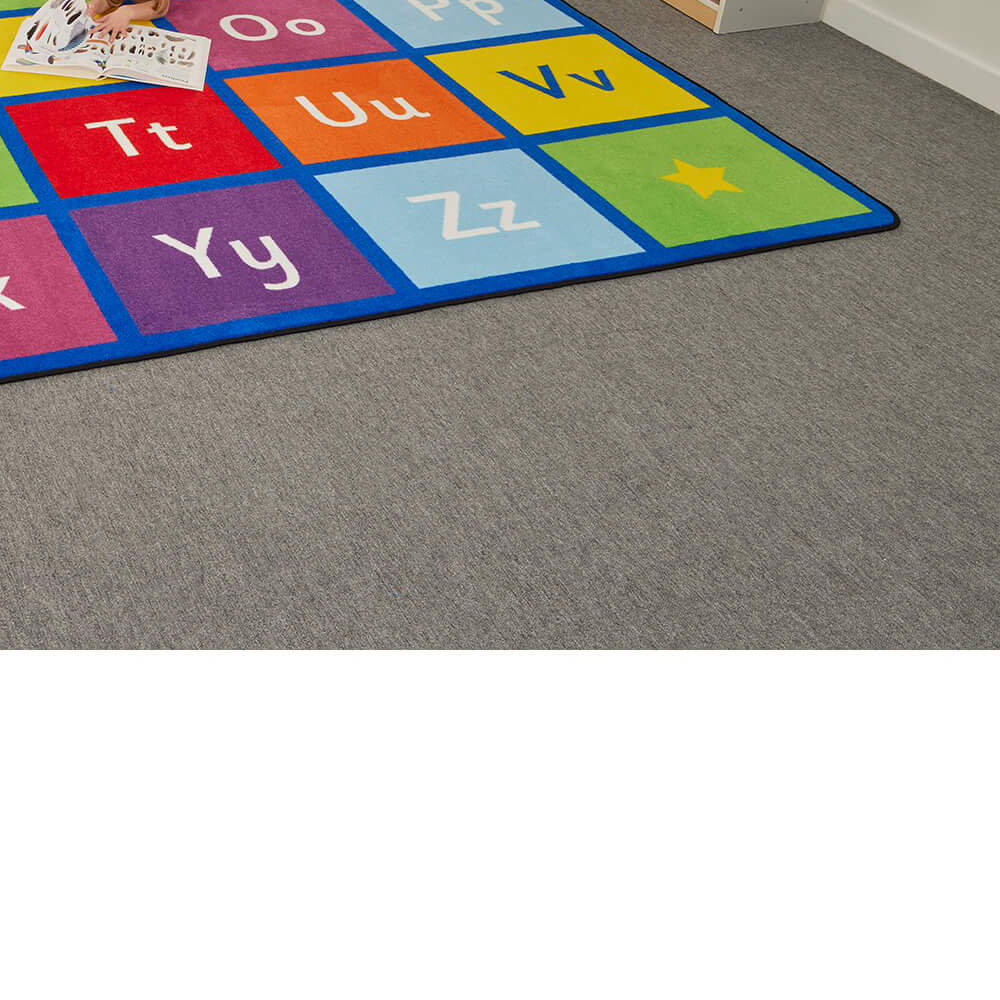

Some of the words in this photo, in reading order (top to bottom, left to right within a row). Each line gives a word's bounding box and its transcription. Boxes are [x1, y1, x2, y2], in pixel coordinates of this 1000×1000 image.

[219, 14, 326, 42] Oo
[497, 64, 615, 99] Vv
[295, 91, 430, 127] Uu
[85, 117, 192, 157] Tt
[406, 189, 543, 242] Zz
[151, 226, 301, 291] Yy
